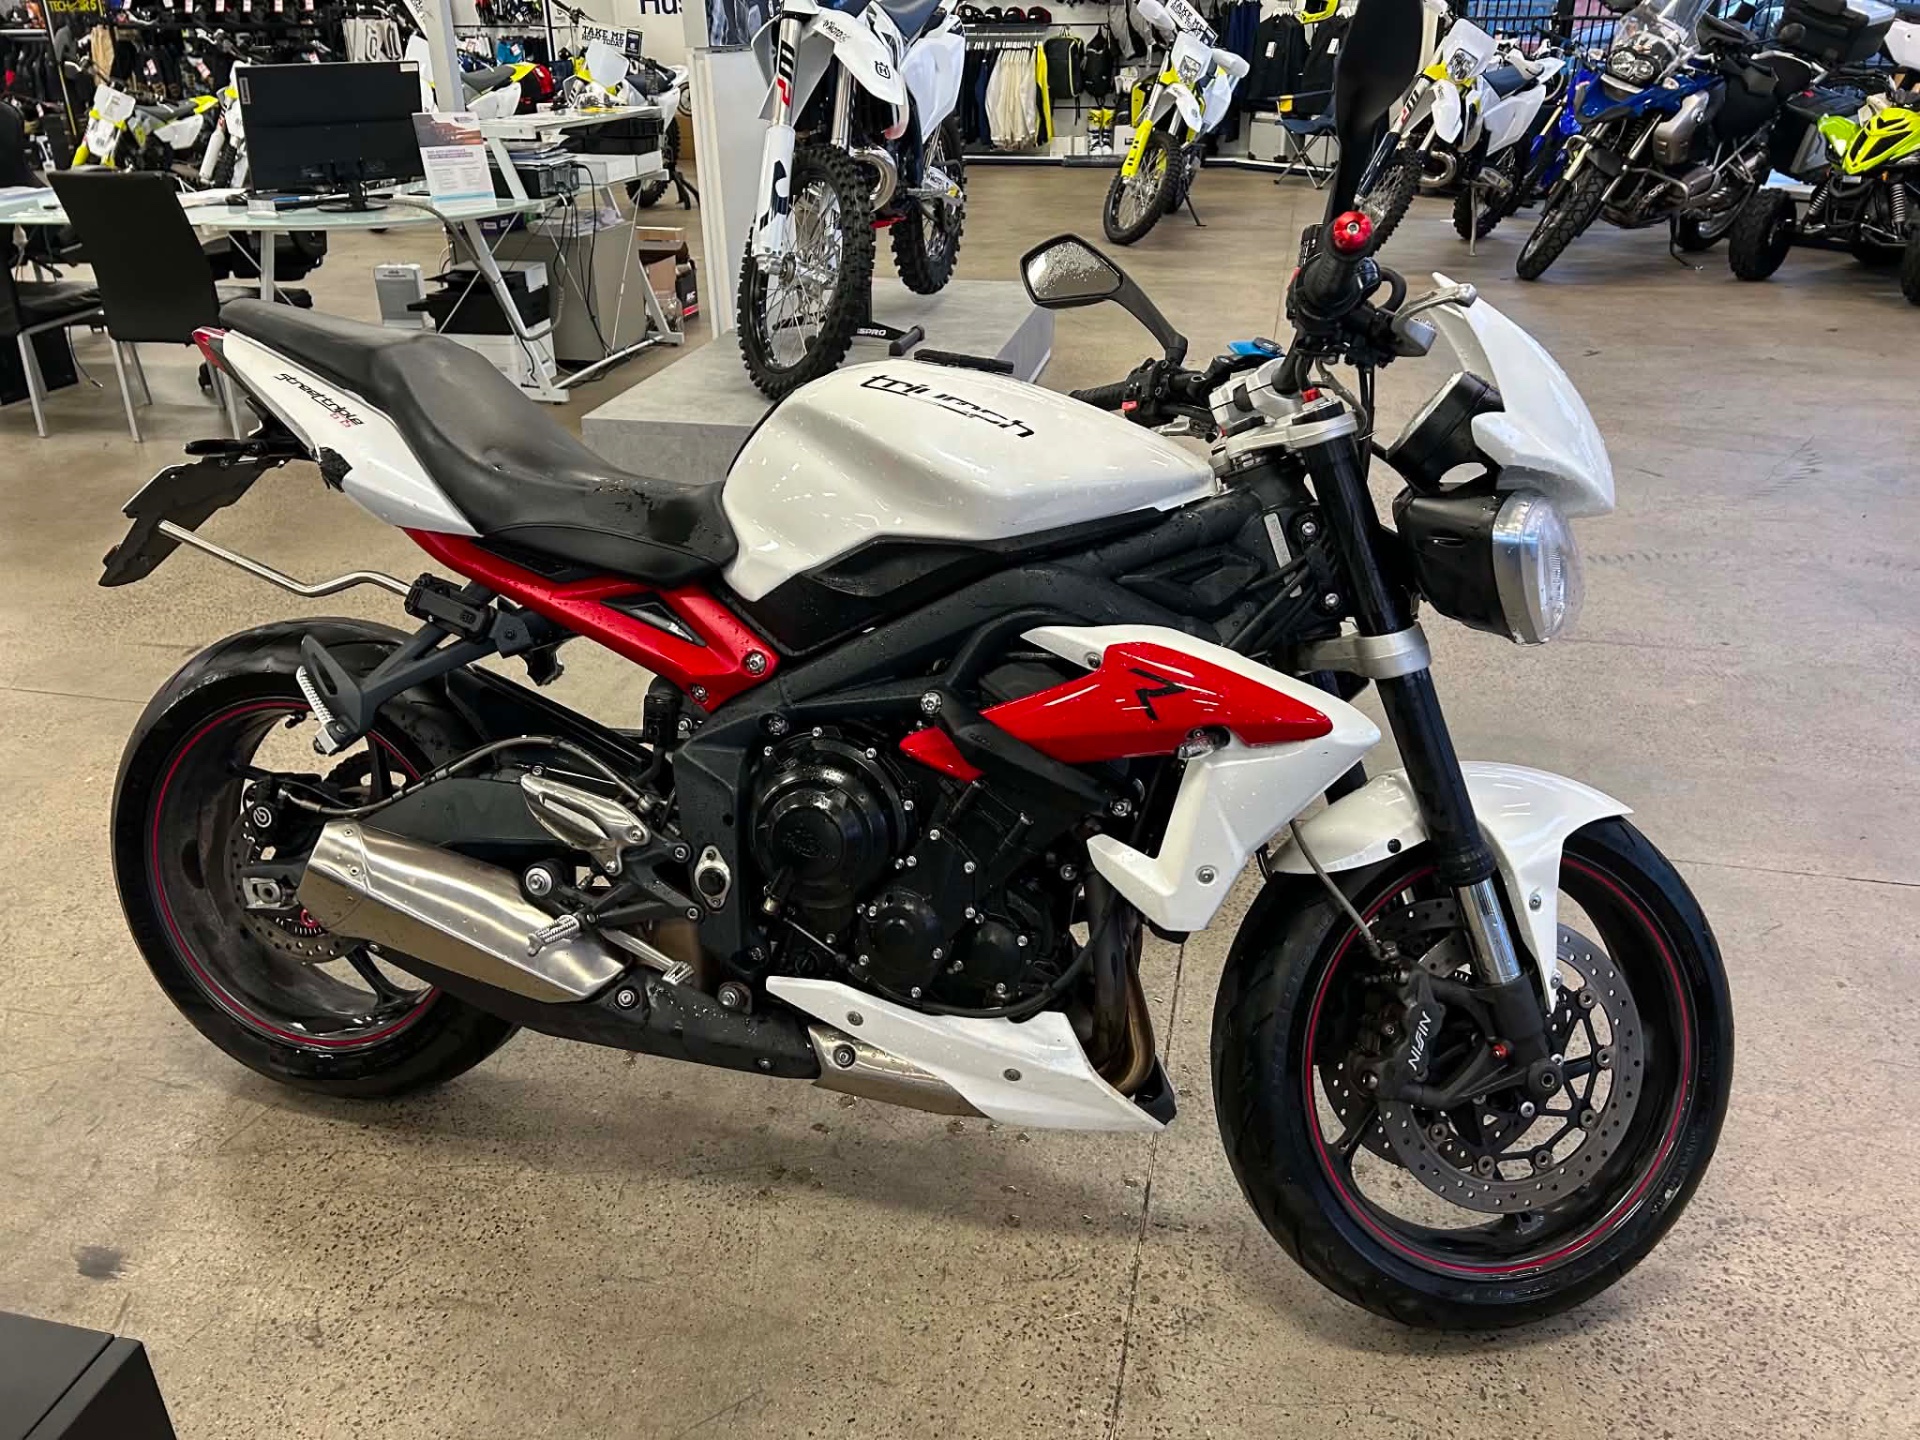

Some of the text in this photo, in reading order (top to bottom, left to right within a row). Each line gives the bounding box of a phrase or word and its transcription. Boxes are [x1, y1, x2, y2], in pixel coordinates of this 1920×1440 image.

[640, 0, 682, 14] Hu
[582, 26, 608, 38] TAKE
[611, 31, 625, 41] ME
[1408, 1010, 1432, 1071] NISSIN
